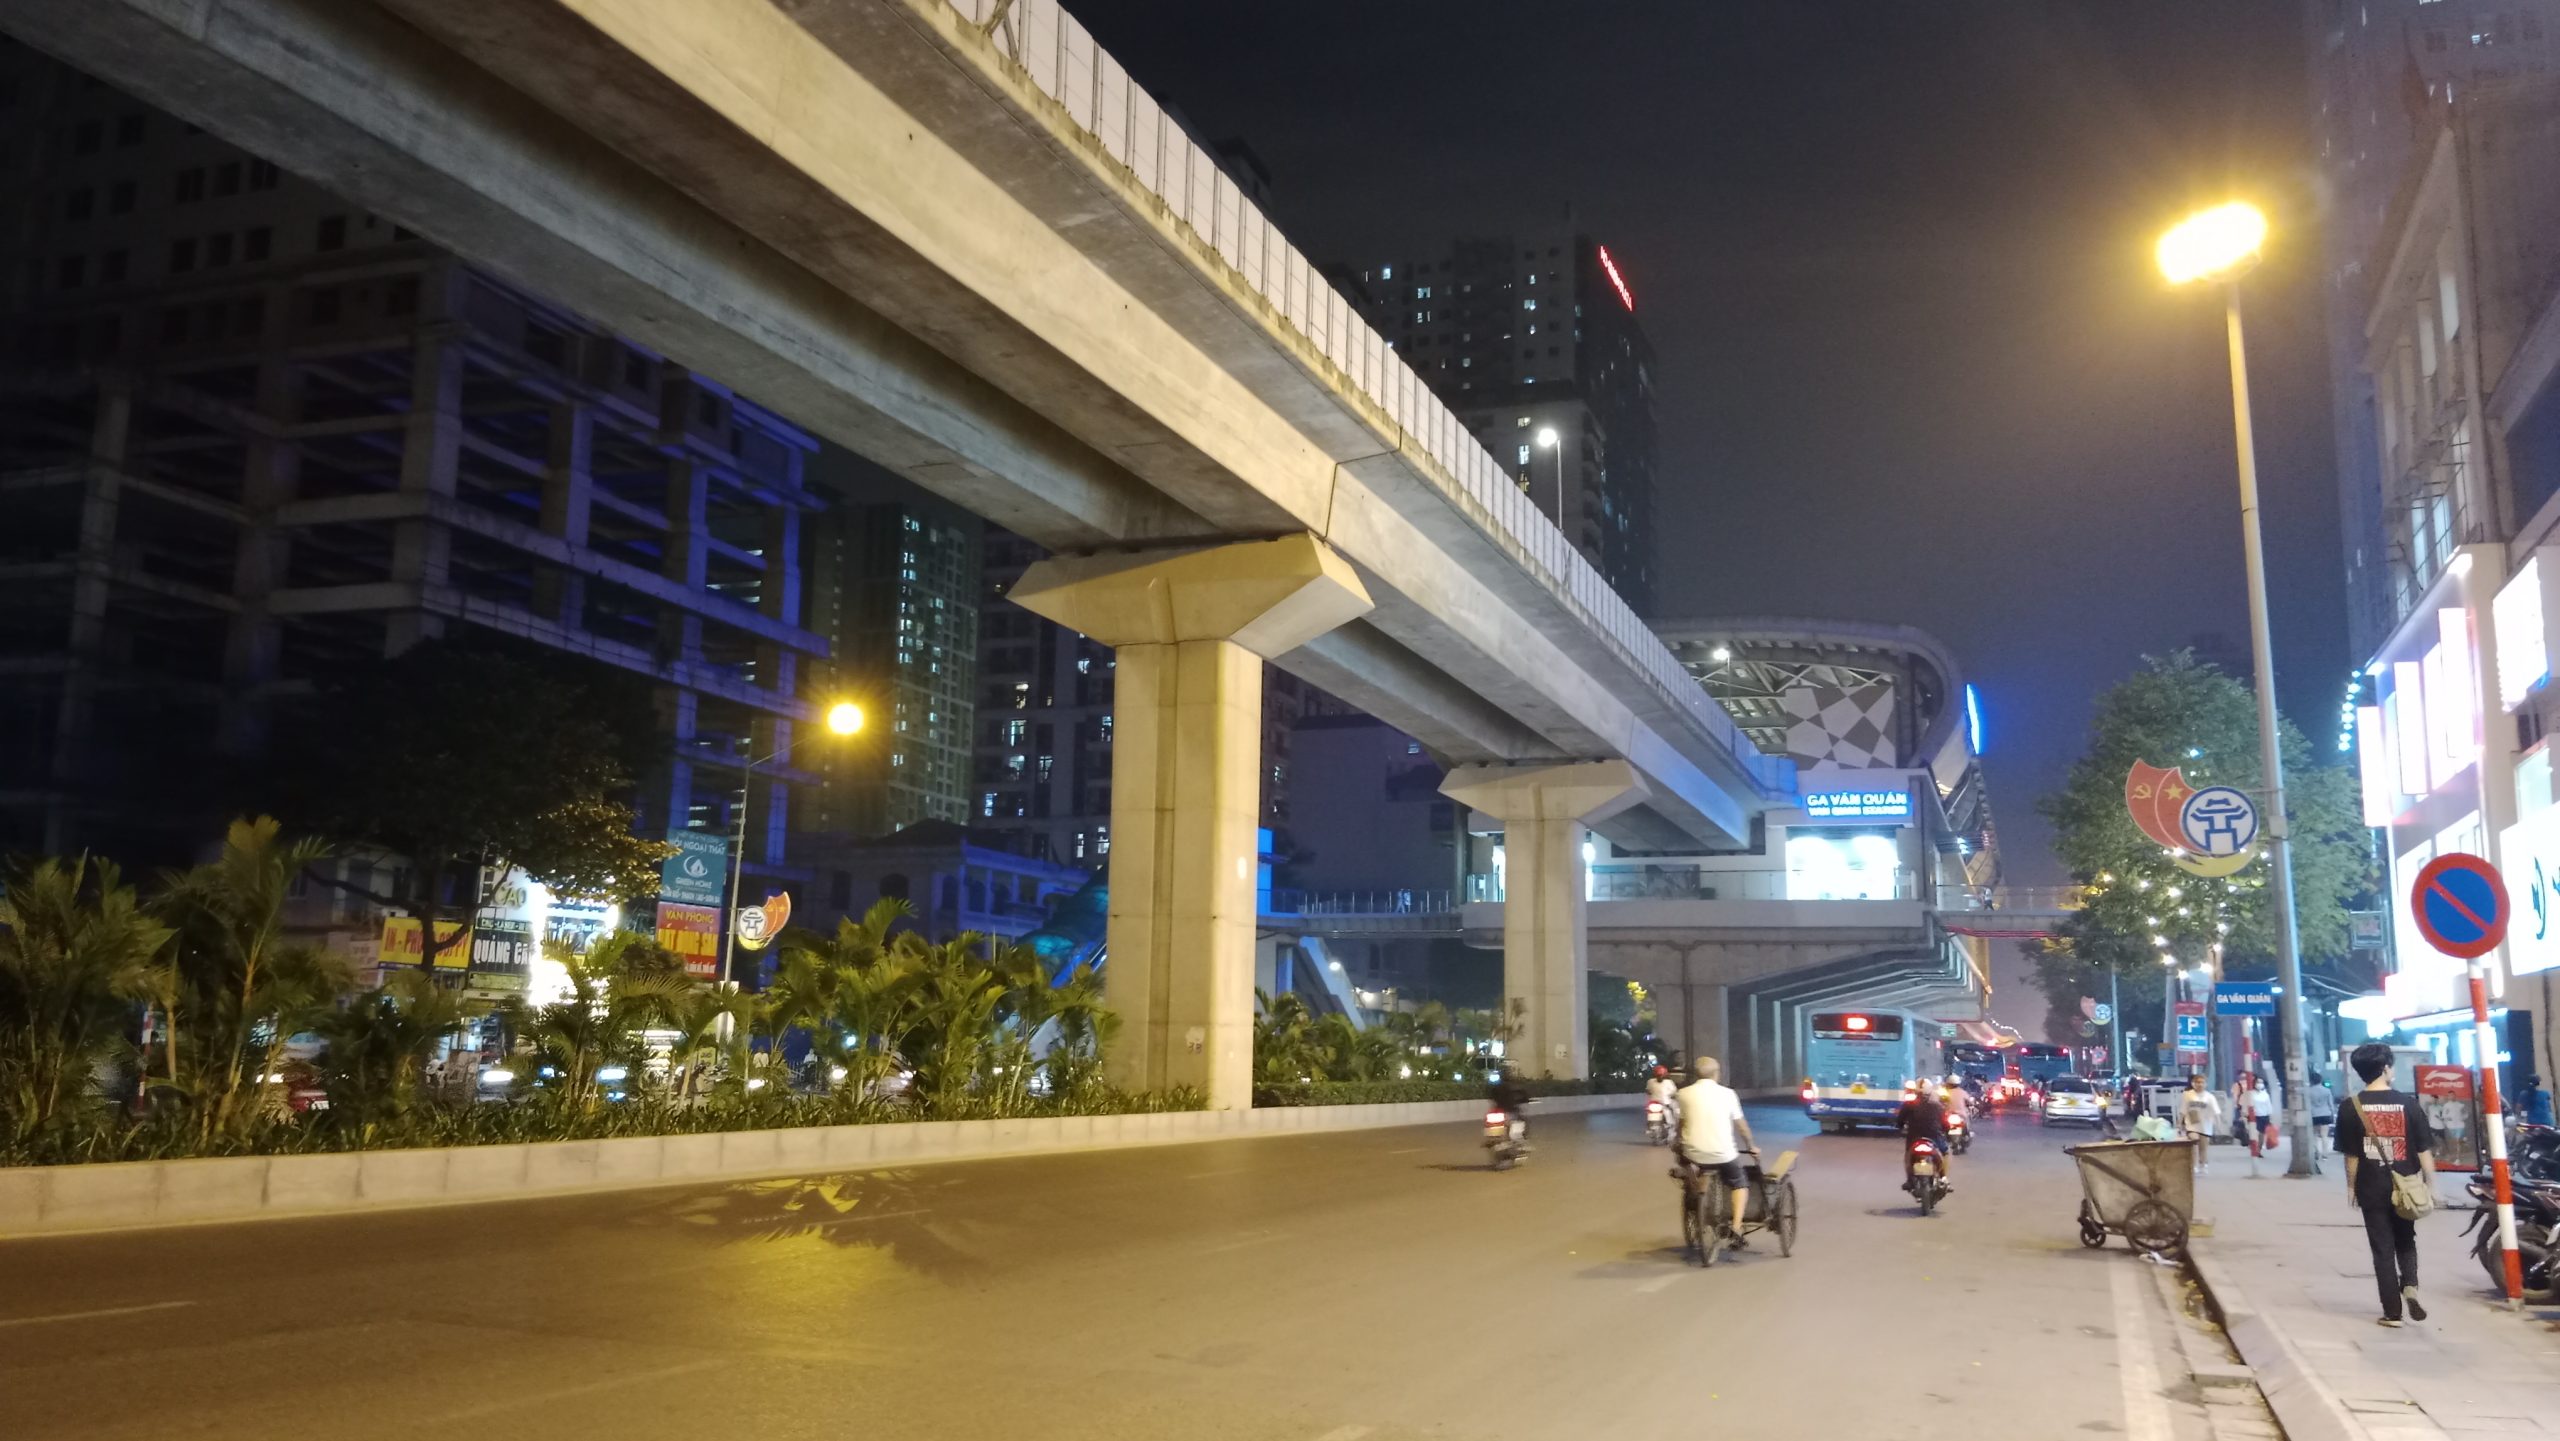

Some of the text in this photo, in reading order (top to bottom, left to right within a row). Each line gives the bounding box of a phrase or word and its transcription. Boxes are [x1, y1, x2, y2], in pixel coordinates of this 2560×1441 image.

[1807, 794, 1829, 806] GA
[473, 935, 511, 964] QUẢNG
[2216, 994, 2229, 1004] GA
[2187, 1018, 2199, 1033] P
